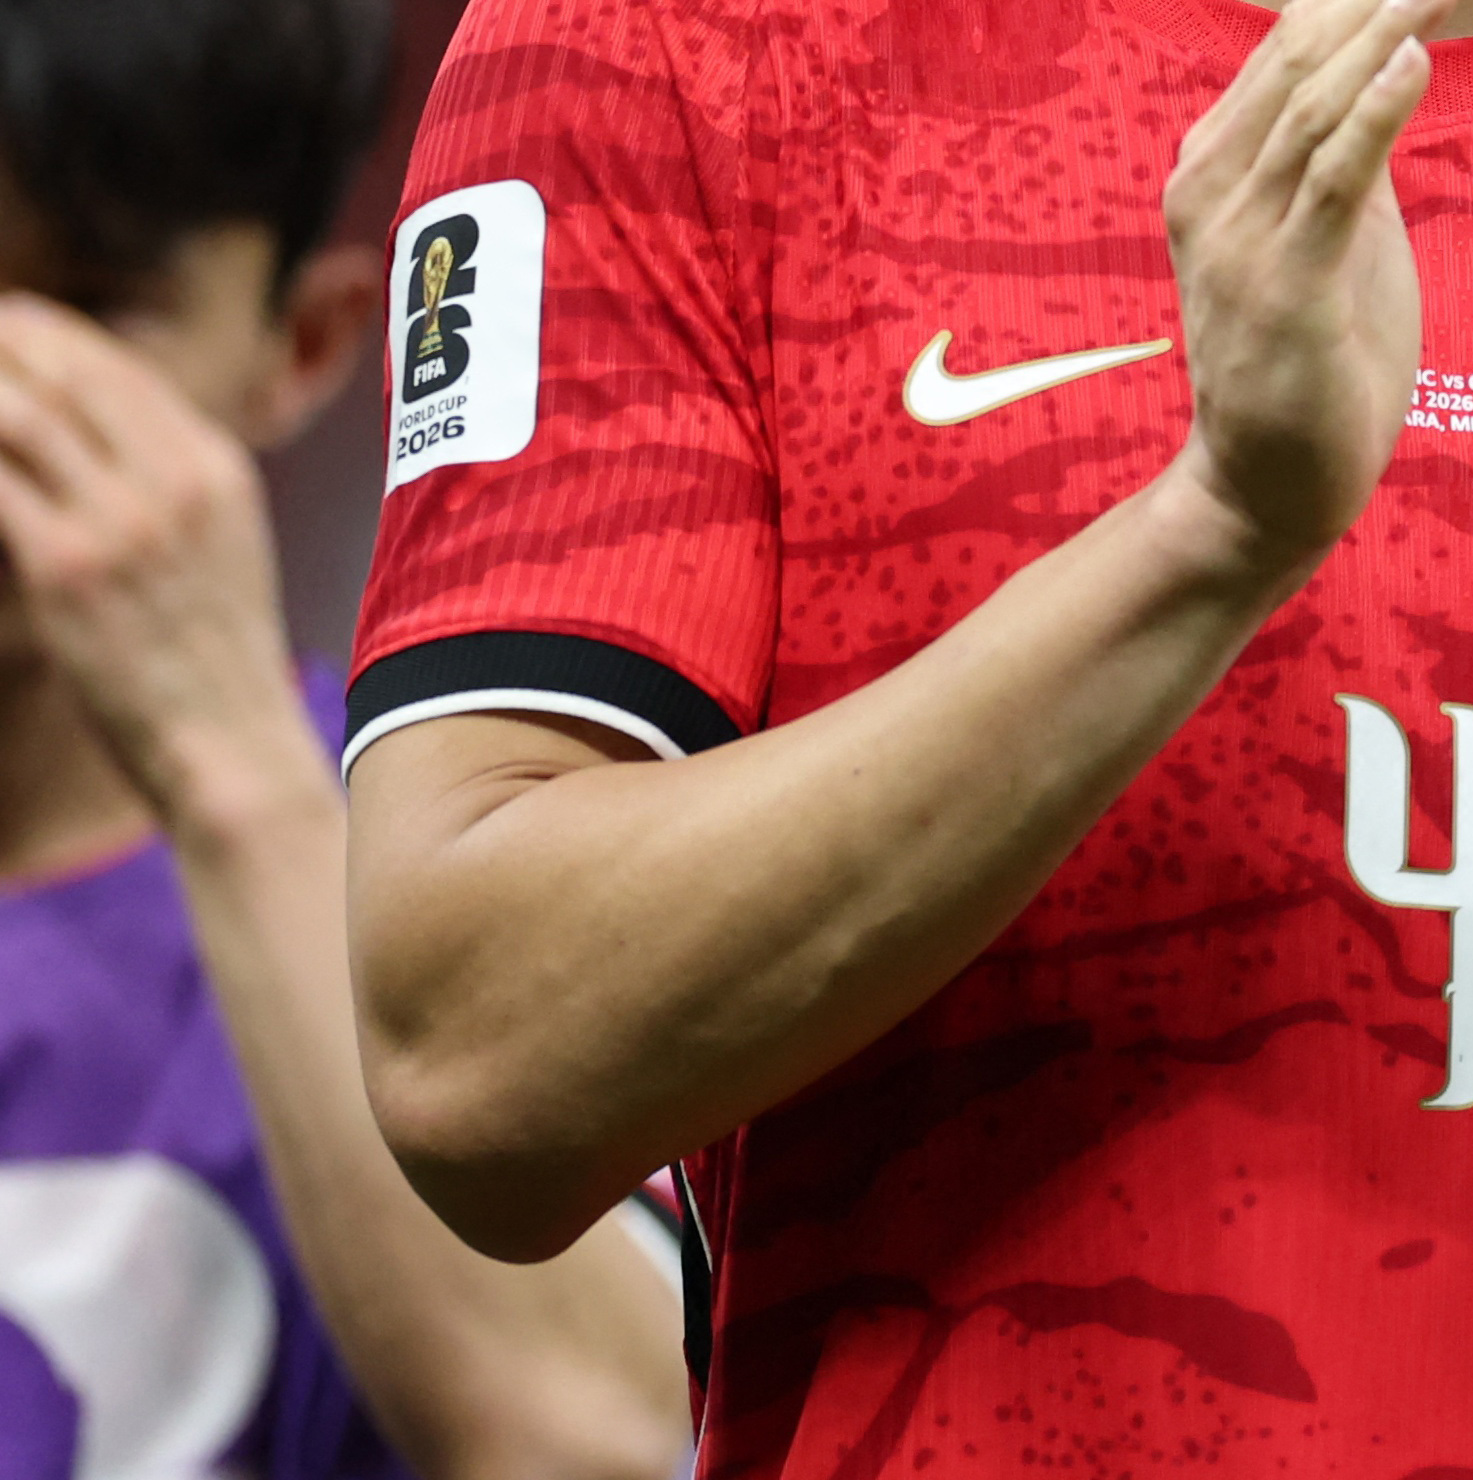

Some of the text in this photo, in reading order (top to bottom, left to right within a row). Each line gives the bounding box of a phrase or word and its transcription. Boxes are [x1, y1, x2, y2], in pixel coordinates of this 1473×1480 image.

[413, 356, 447, 388] FIFA
[438, 395, 467, 413] CUP
[396, 415, 465, 461] 2026
